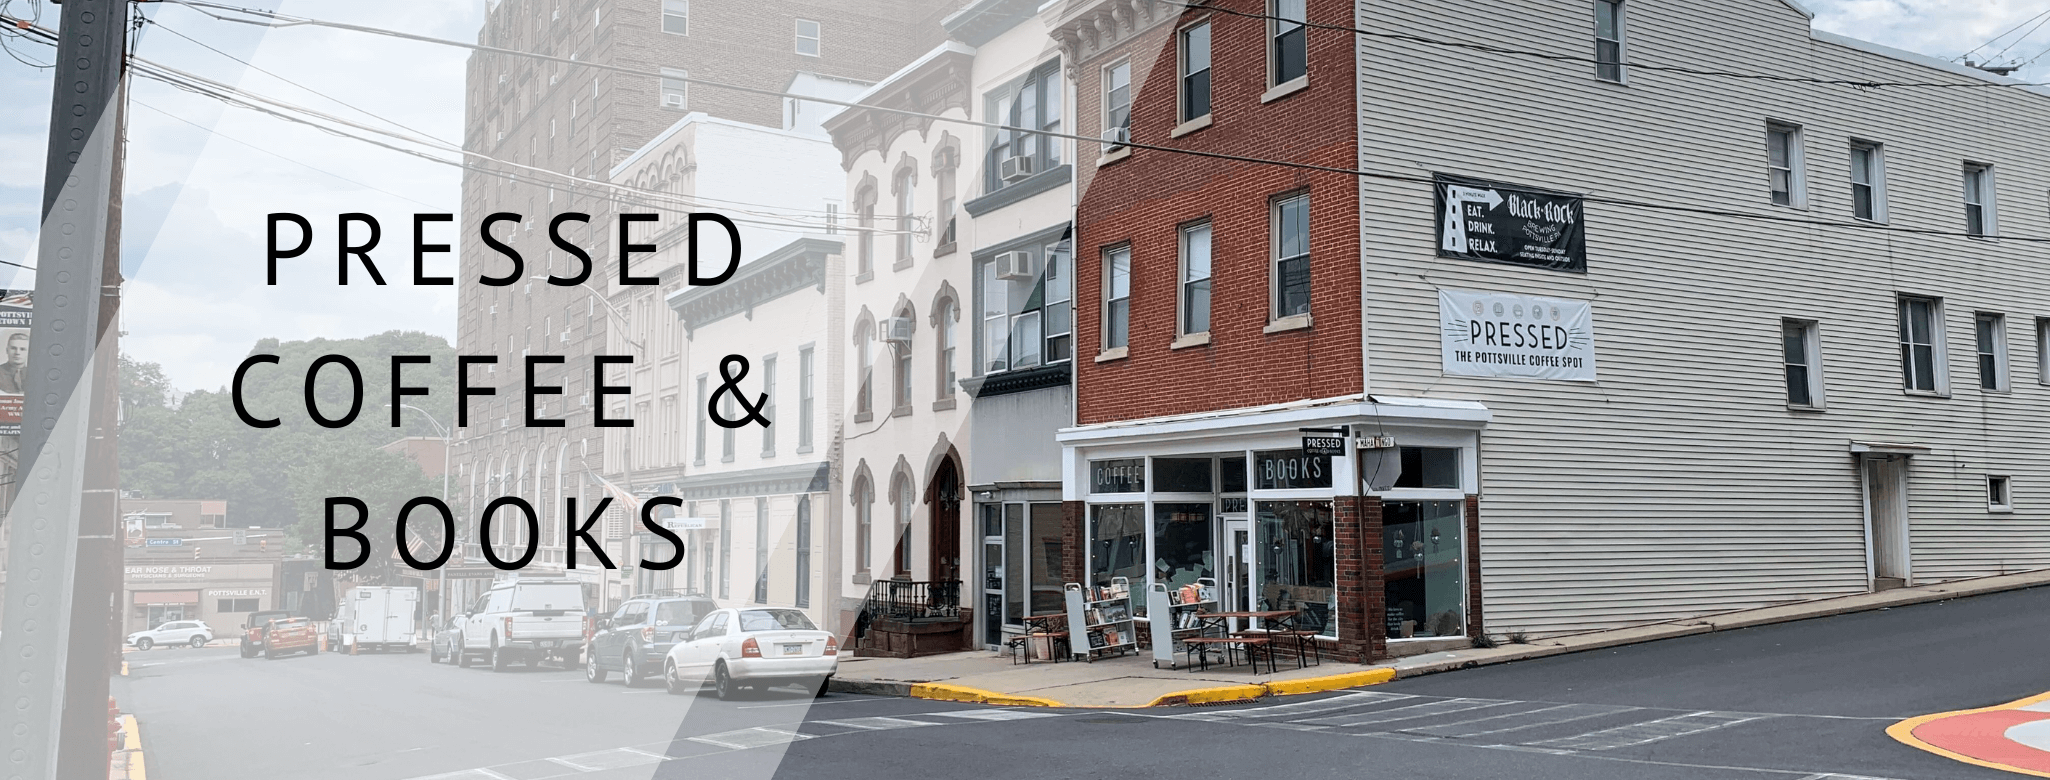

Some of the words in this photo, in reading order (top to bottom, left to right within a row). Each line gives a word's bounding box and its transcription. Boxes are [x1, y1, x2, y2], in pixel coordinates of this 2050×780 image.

[1467, 204, 1485, 218] EAT.
[1468, 220, 1496, 235] DRINK.
[1521, 224, 1554, 243] POTTSVILLE
[1527, 219, 1556, 233] BREWING
[1469, 237, 1498, 253] RELAX.
[1470, 319, 1568, 350] PRESSED
[1455, 350, 1472, 363] THE
[1475, 351, 1526, 366] POTTSVILLE
[1529, 354, 1559, 367] COFFEE
[1562, 356, 1583, 369] SPOT
[1307, 438, 1341, 448] PRESSED
[1097, 465, 1140, 485] COFFEE
[1265, 456, 1322, 481] BOOKS
